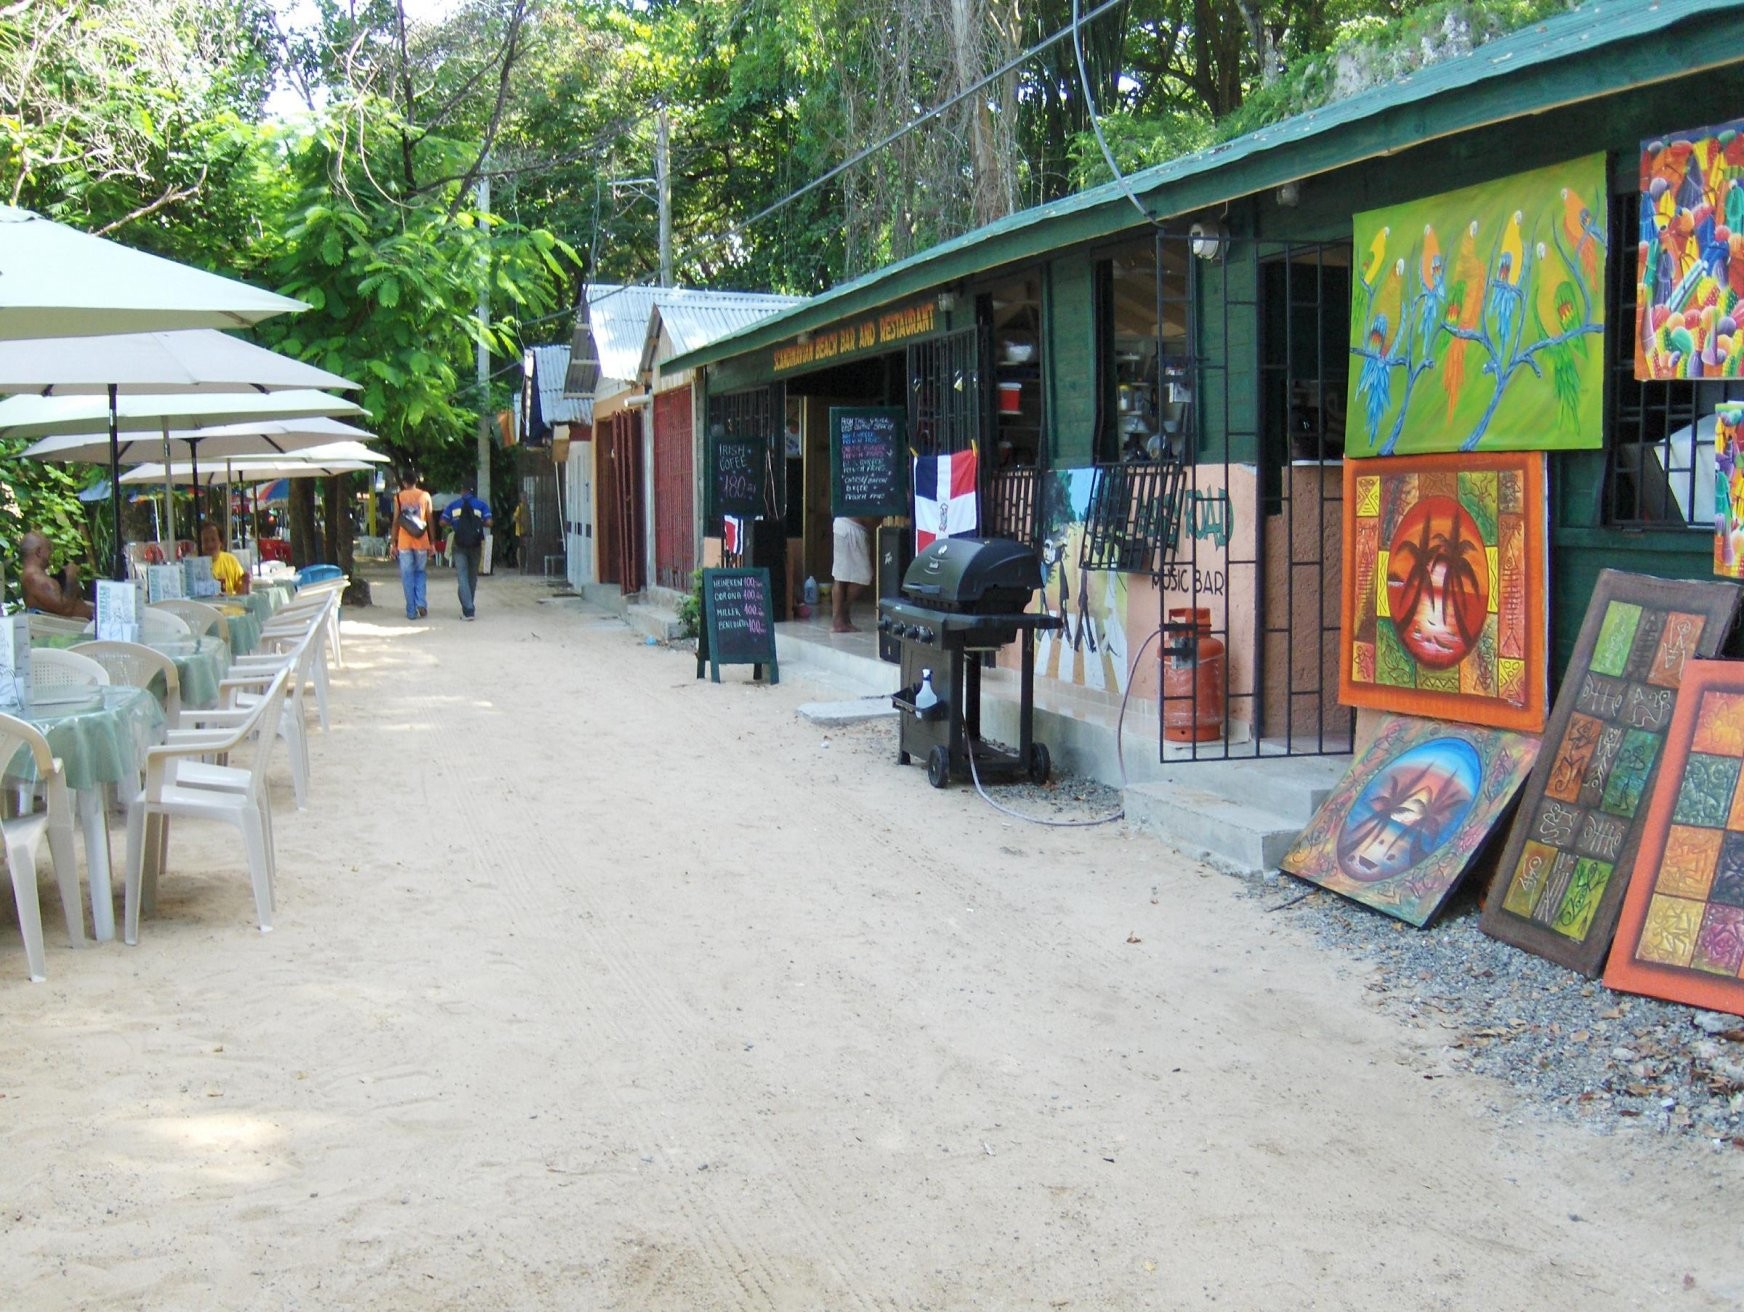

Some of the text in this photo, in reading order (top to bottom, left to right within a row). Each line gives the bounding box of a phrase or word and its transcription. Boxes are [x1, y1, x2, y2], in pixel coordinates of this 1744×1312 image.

[815, 335, 837, 360] BEACH
[840, 328, 855, 353] BAR
[859, 322, 875, 348] AND
[880, 303, 934, 342] RESTAURANT
[719, 443, 745, 457] IRISH
[713, 577, 743, 588] HEINEKEN
[1152, 567, 1225, 596] MUSIC BAR
[714, 591, 742, 602] CORONA
[716, 607, 743, 617] MILLER
